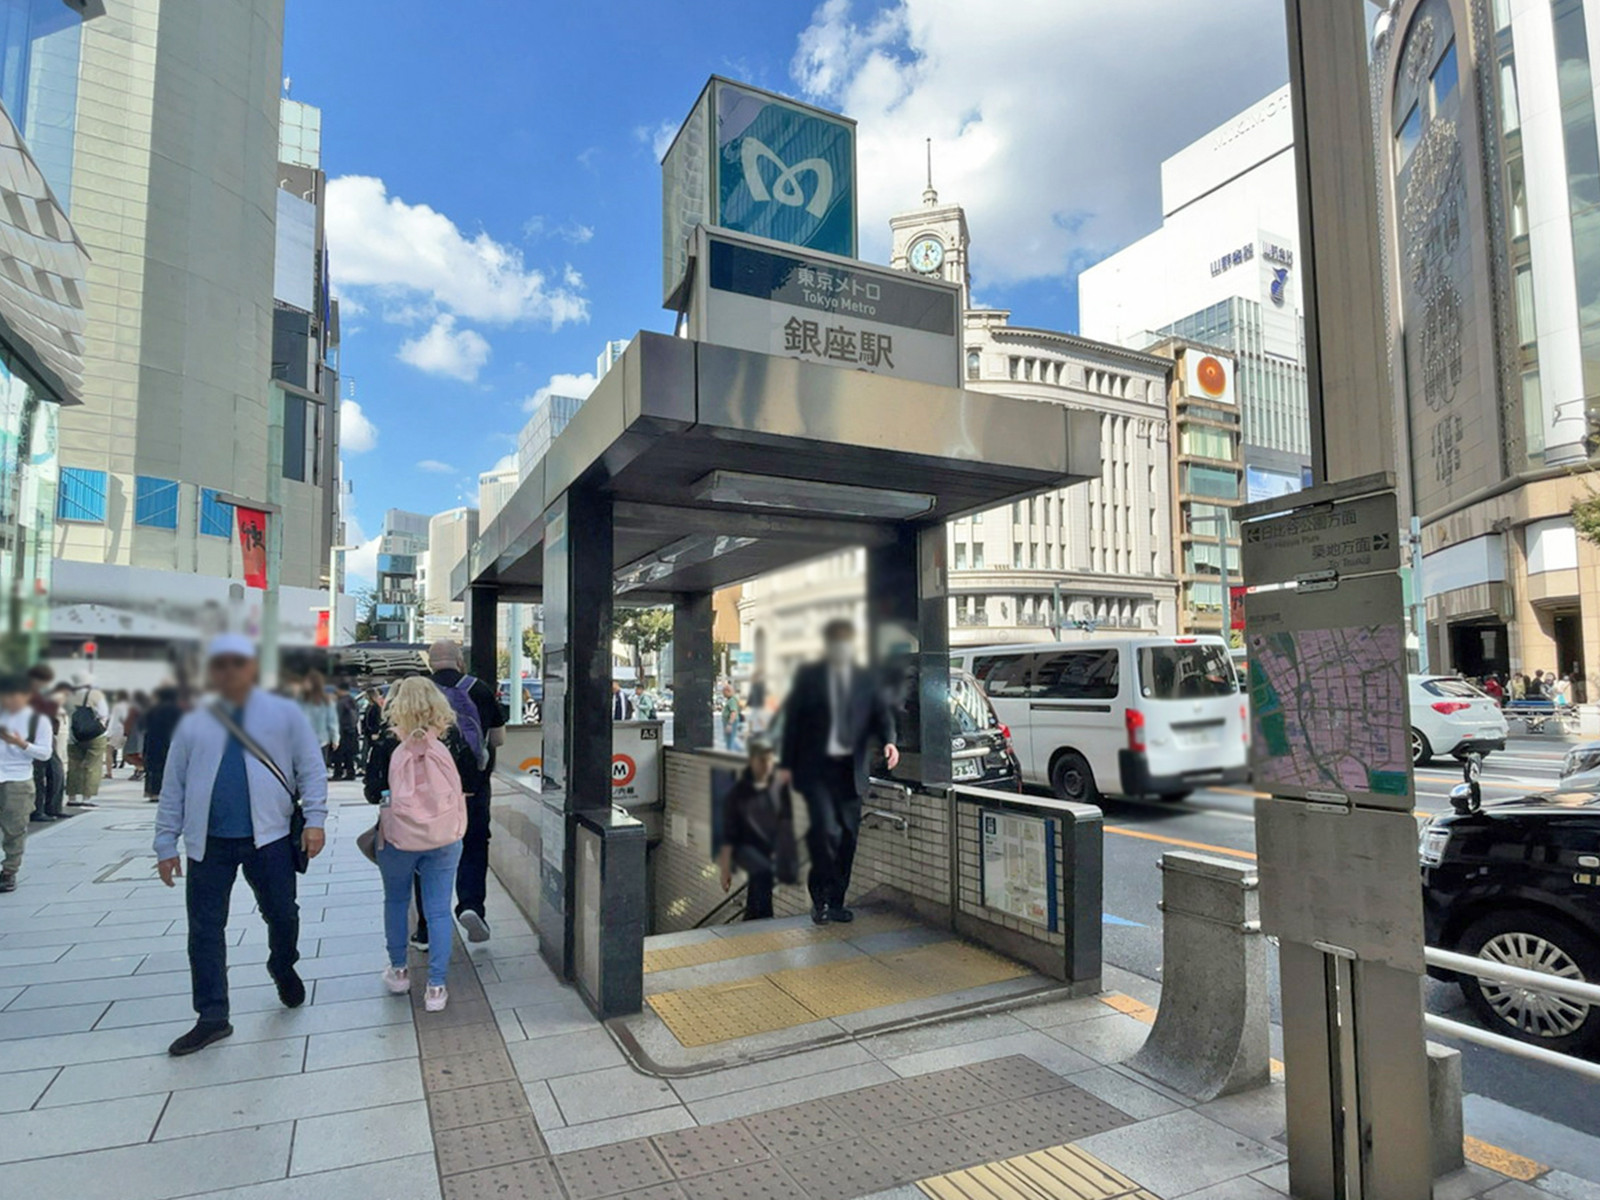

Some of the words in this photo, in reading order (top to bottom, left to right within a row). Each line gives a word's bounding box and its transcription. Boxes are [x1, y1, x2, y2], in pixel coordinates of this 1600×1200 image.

[797, 267, 880, 300] 東京メトロ
[803, 289, 838, 308] Tokyo
[841, 297, 876, 316] Metro
[784, 316, 894, 369] 銀座駅
[1262, 509, 1356, 540] 日比谷公園方面
[1312, 536, 1371, 560] 築地方面
[643, 729, 656, 739] A5
[613, 764, 626, 776] M
